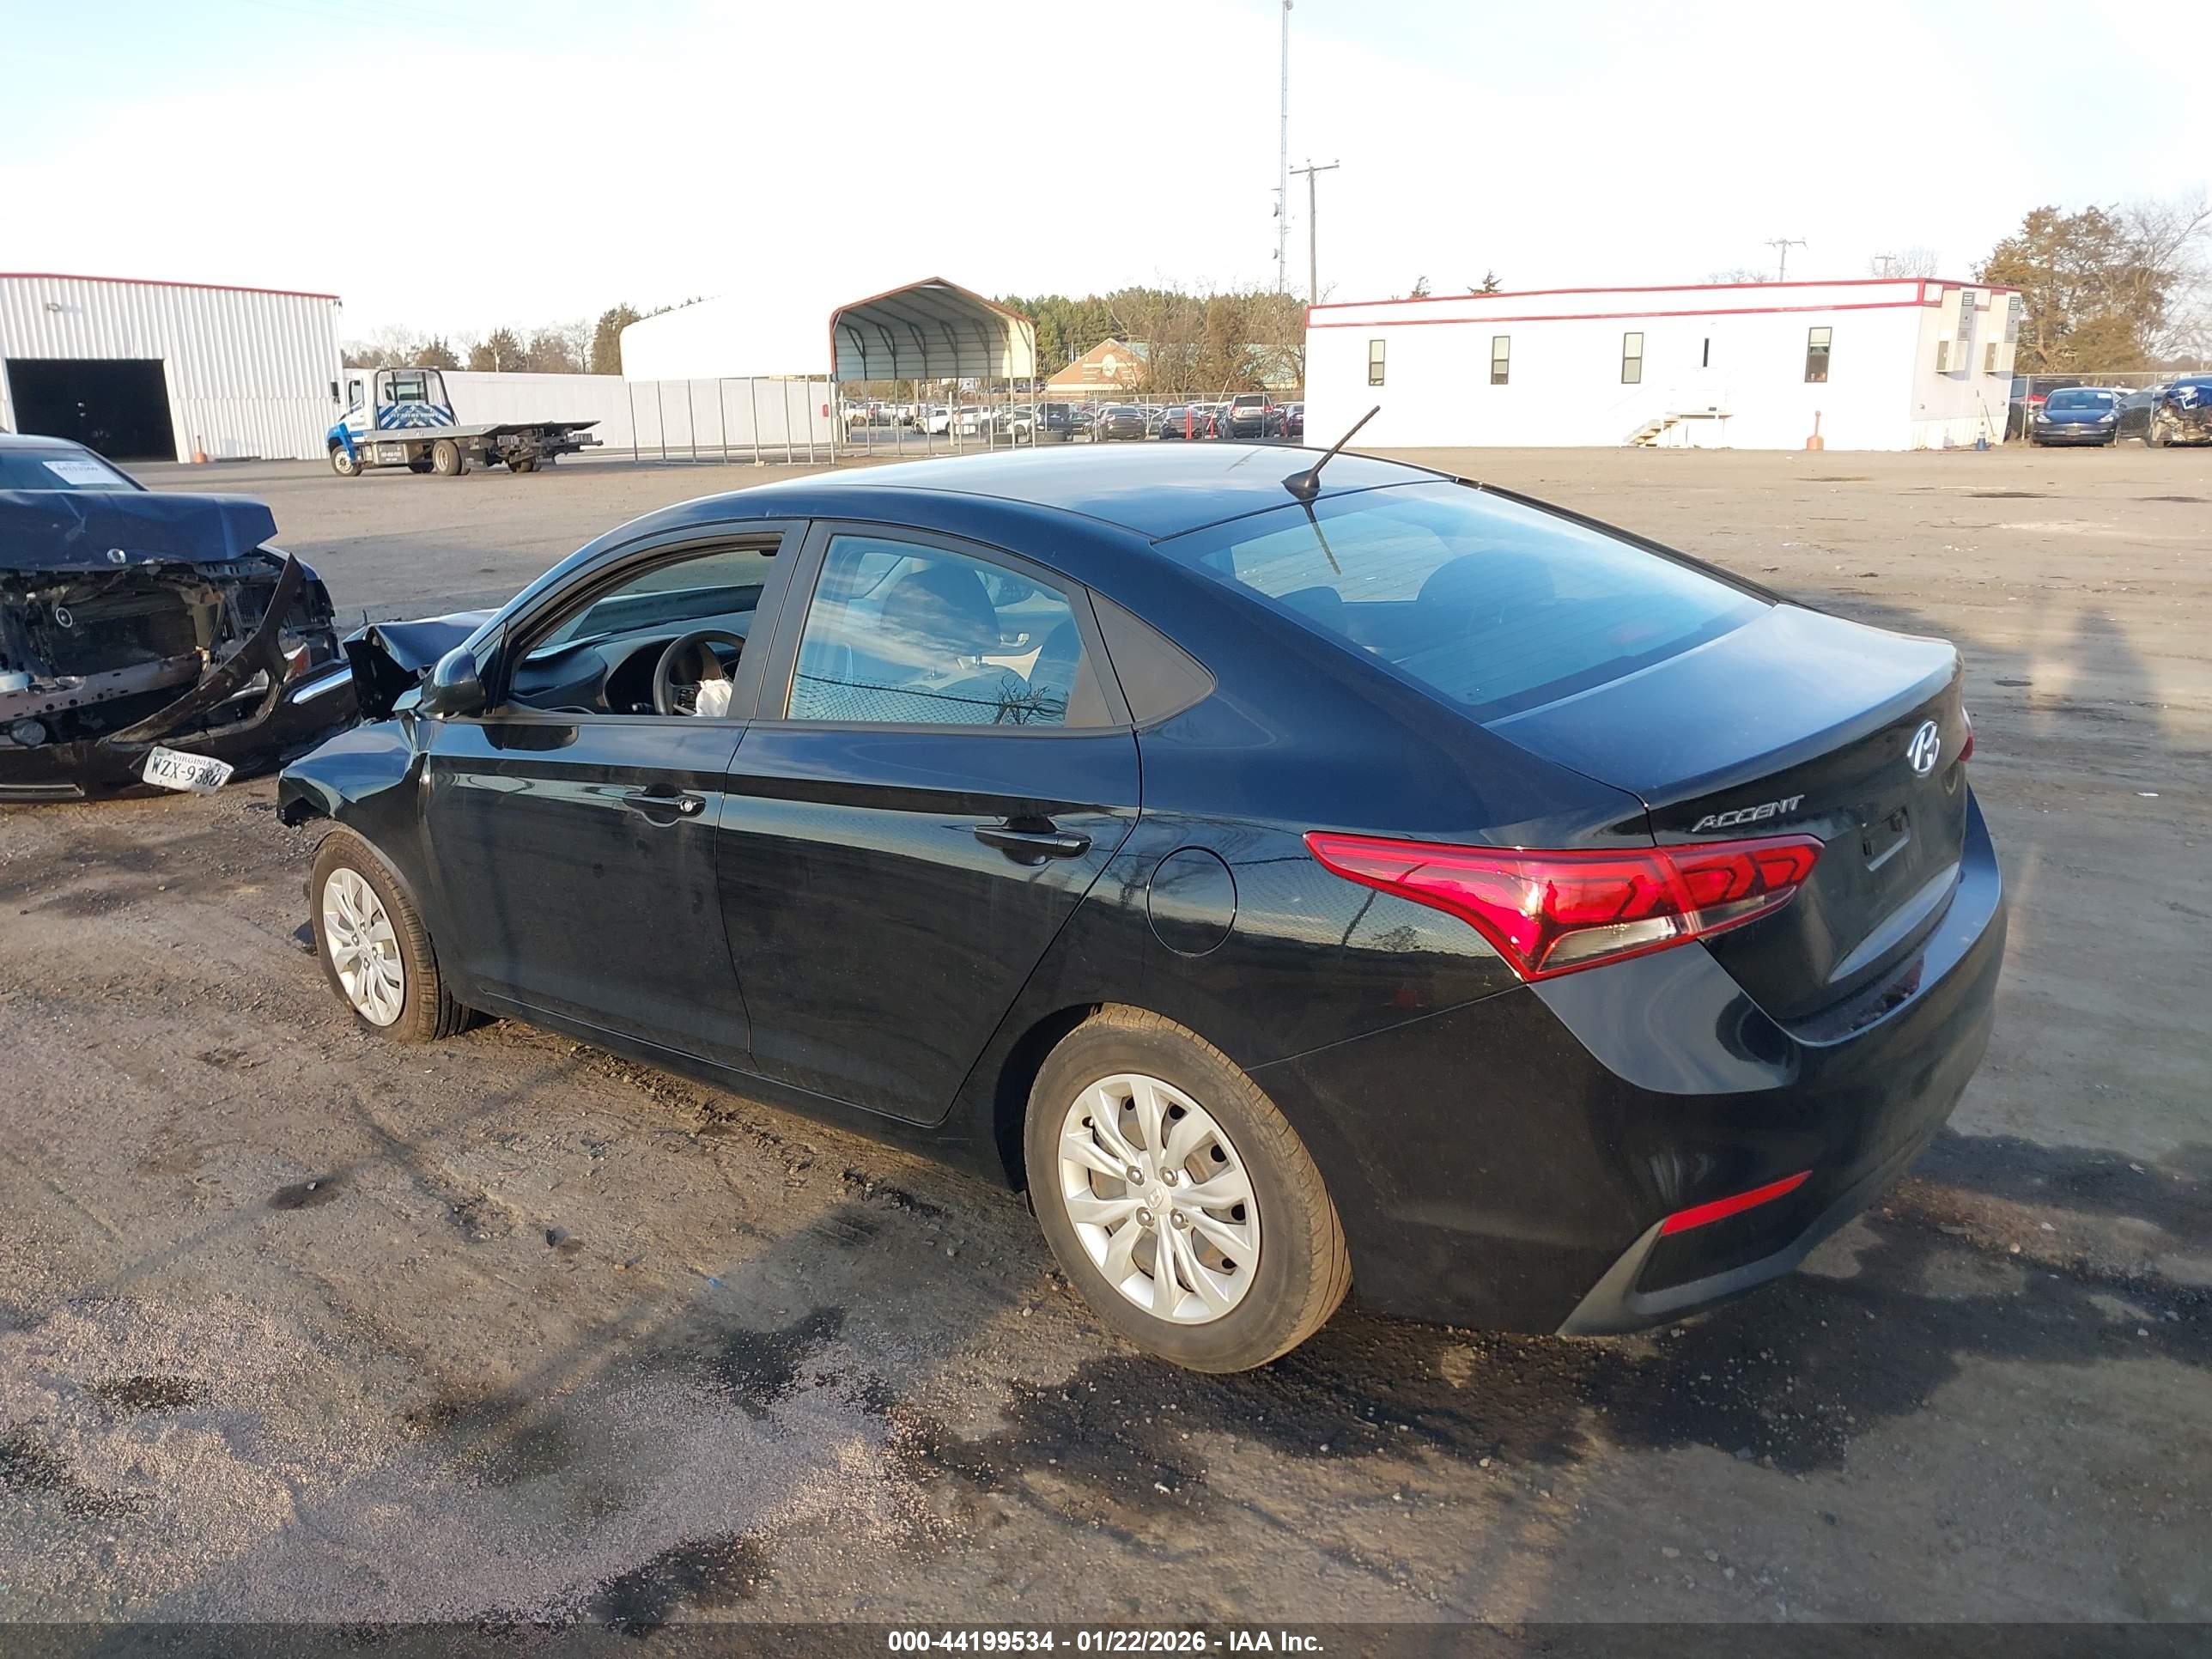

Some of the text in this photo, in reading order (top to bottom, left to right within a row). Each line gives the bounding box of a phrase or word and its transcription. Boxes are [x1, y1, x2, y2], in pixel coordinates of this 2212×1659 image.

[151, 757, 222, 787] WZX-9380
[173, 755, 211, 769] VIRGINIA
[1692, 794, 1805, 832] ACCENT
